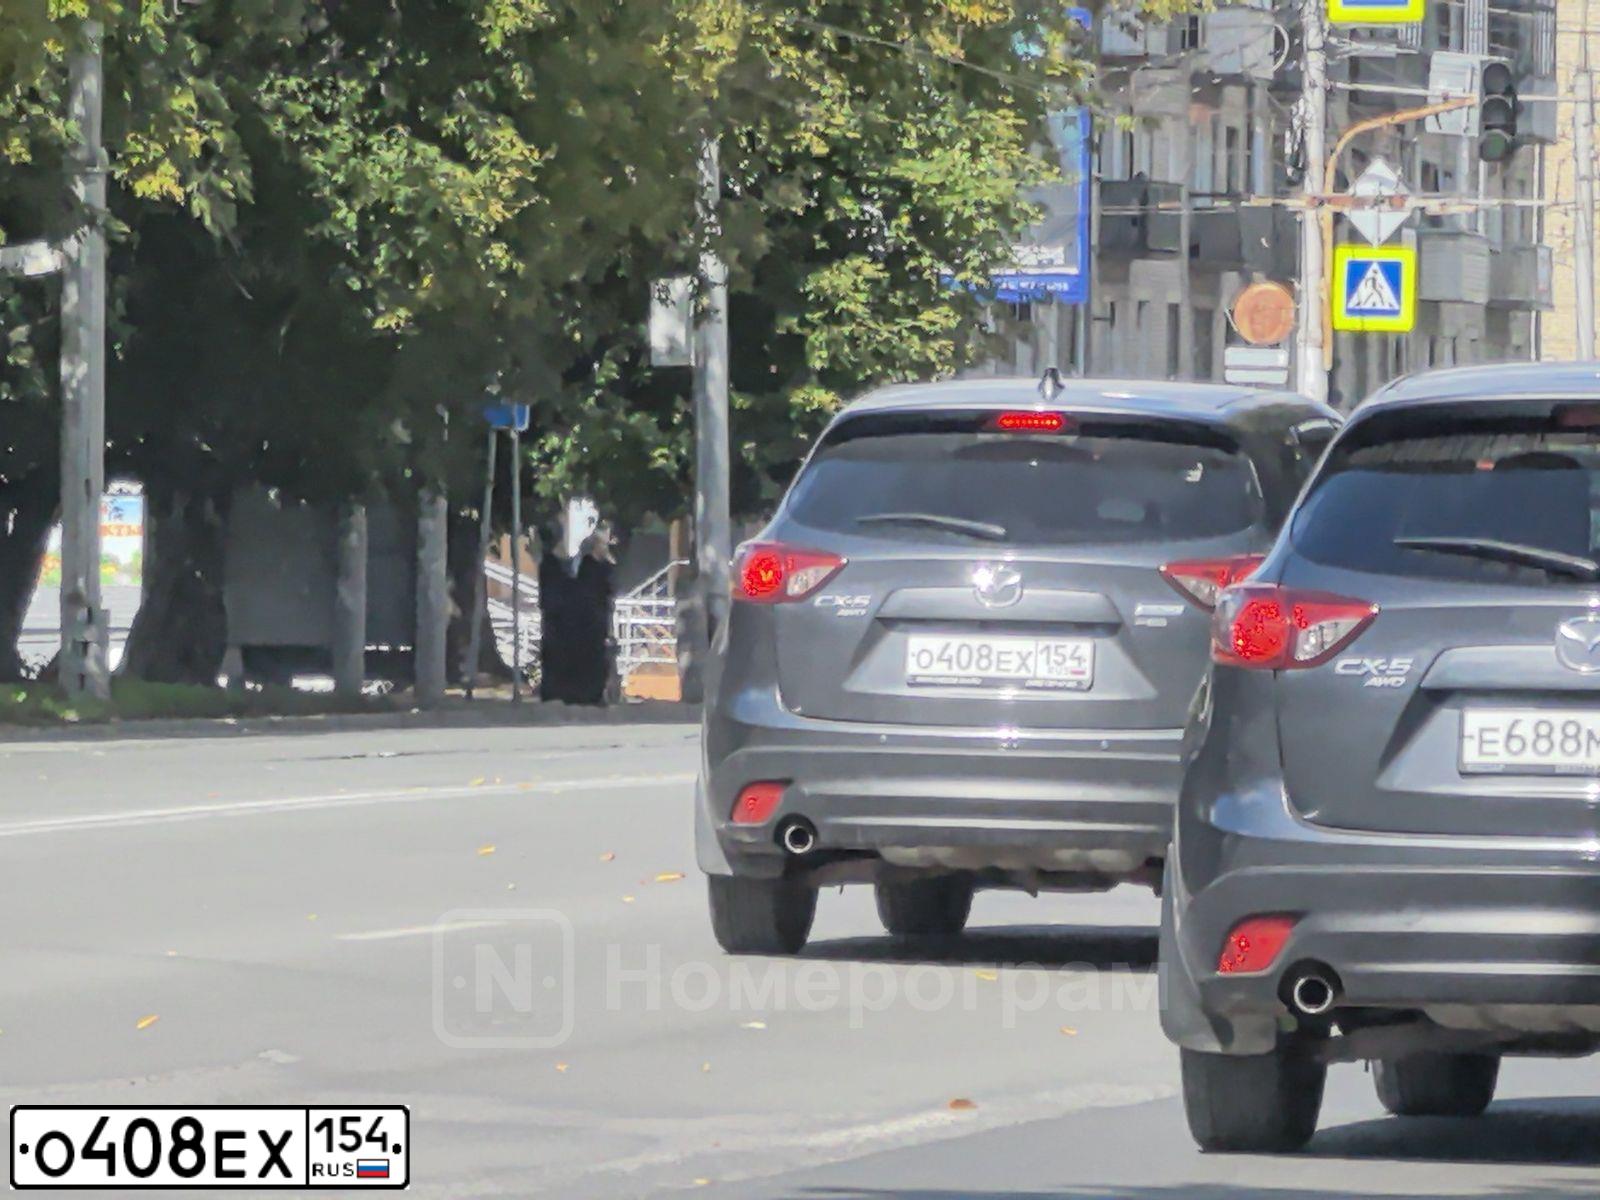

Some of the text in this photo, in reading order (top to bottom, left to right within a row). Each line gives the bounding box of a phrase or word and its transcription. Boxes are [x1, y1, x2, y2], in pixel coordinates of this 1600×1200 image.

[916, 641, 1083, 674] О408ЕХ 154
[1335, 658, 1413, 675] CX-5
[1363, 676, 1406, 687] AWD
